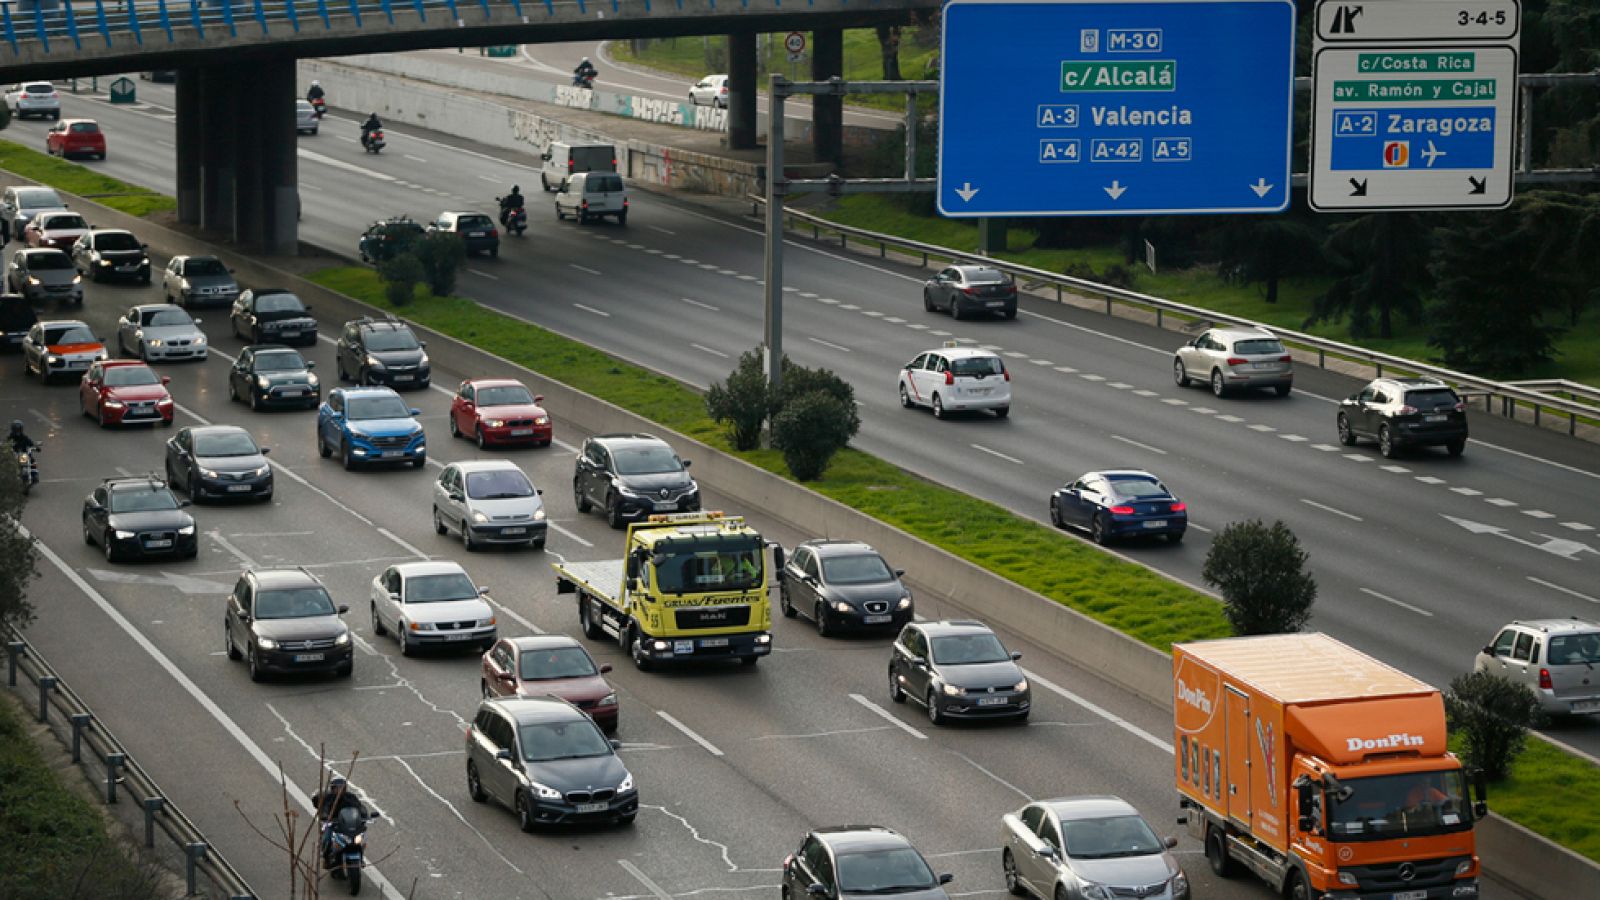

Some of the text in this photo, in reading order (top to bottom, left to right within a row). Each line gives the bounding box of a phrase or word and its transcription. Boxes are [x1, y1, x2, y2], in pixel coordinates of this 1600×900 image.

[1457, 10, 1506, 26] 3-4-5
[1110, 33, 1159, 49] M-30
[1361, 55, 1472, 70] c/Costa Rica
[1065, 65, 1172, 86] c/Alcalá
[1335, 81, 1495, 98] av. Ramón y Cajal
[1041, 106, 1192, 126] A-3 Valencia
[1339, 114, 1492, 136] A-2 Zaragoza
[1043, 141, 1189, 159] A-4 A-42 A-5
[700, 612, 727, 620] MAN
[1178, 679, 1212, 715] DonPin
[1346, 733, 1425, 751] DonPin
